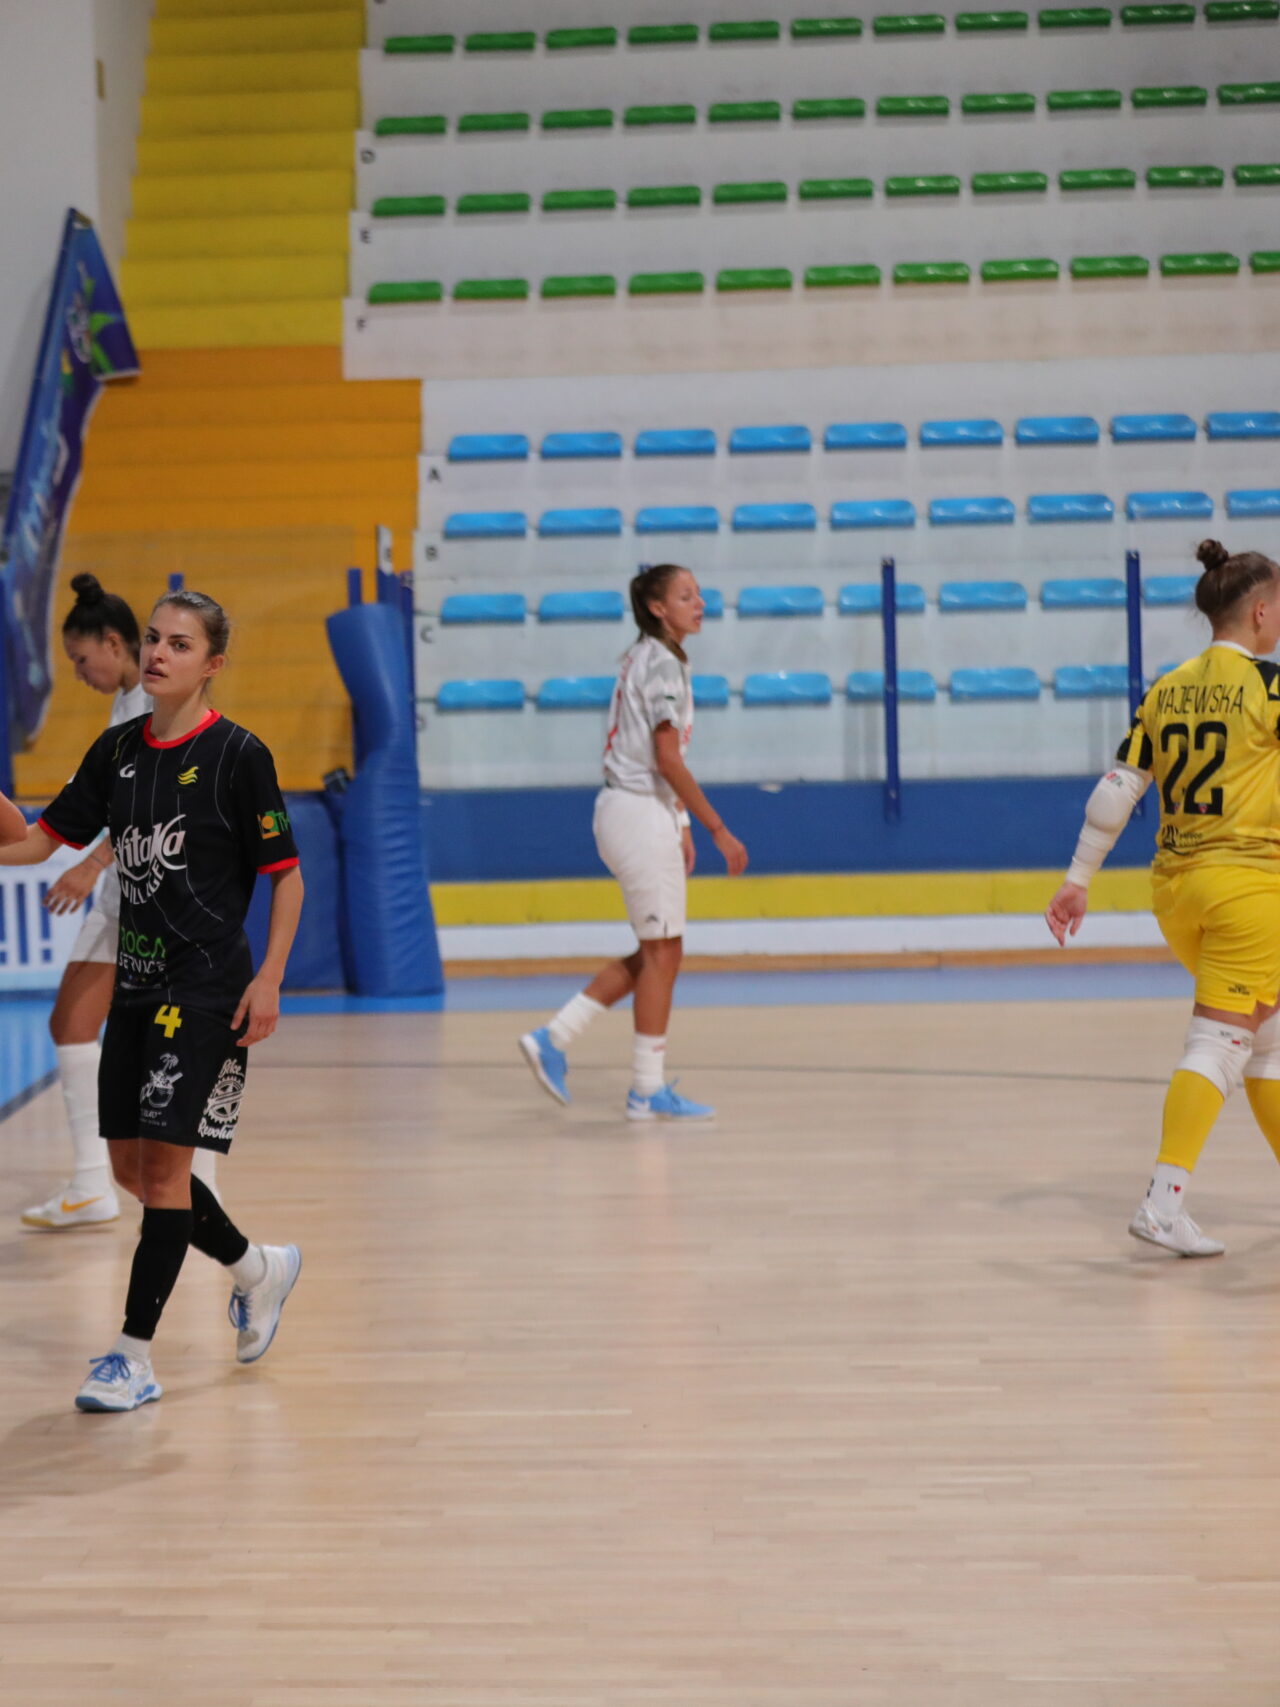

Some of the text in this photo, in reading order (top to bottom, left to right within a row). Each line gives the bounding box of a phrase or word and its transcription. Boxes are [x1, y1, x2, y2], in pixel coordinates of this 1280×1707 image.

[427, 466, 442, 483] A
[425, 545, 438, 561] B
[420, 625, 435, 644] C
[1161, 721, 1227, 816] 22
[154, 1004, 183, 1039] 4
